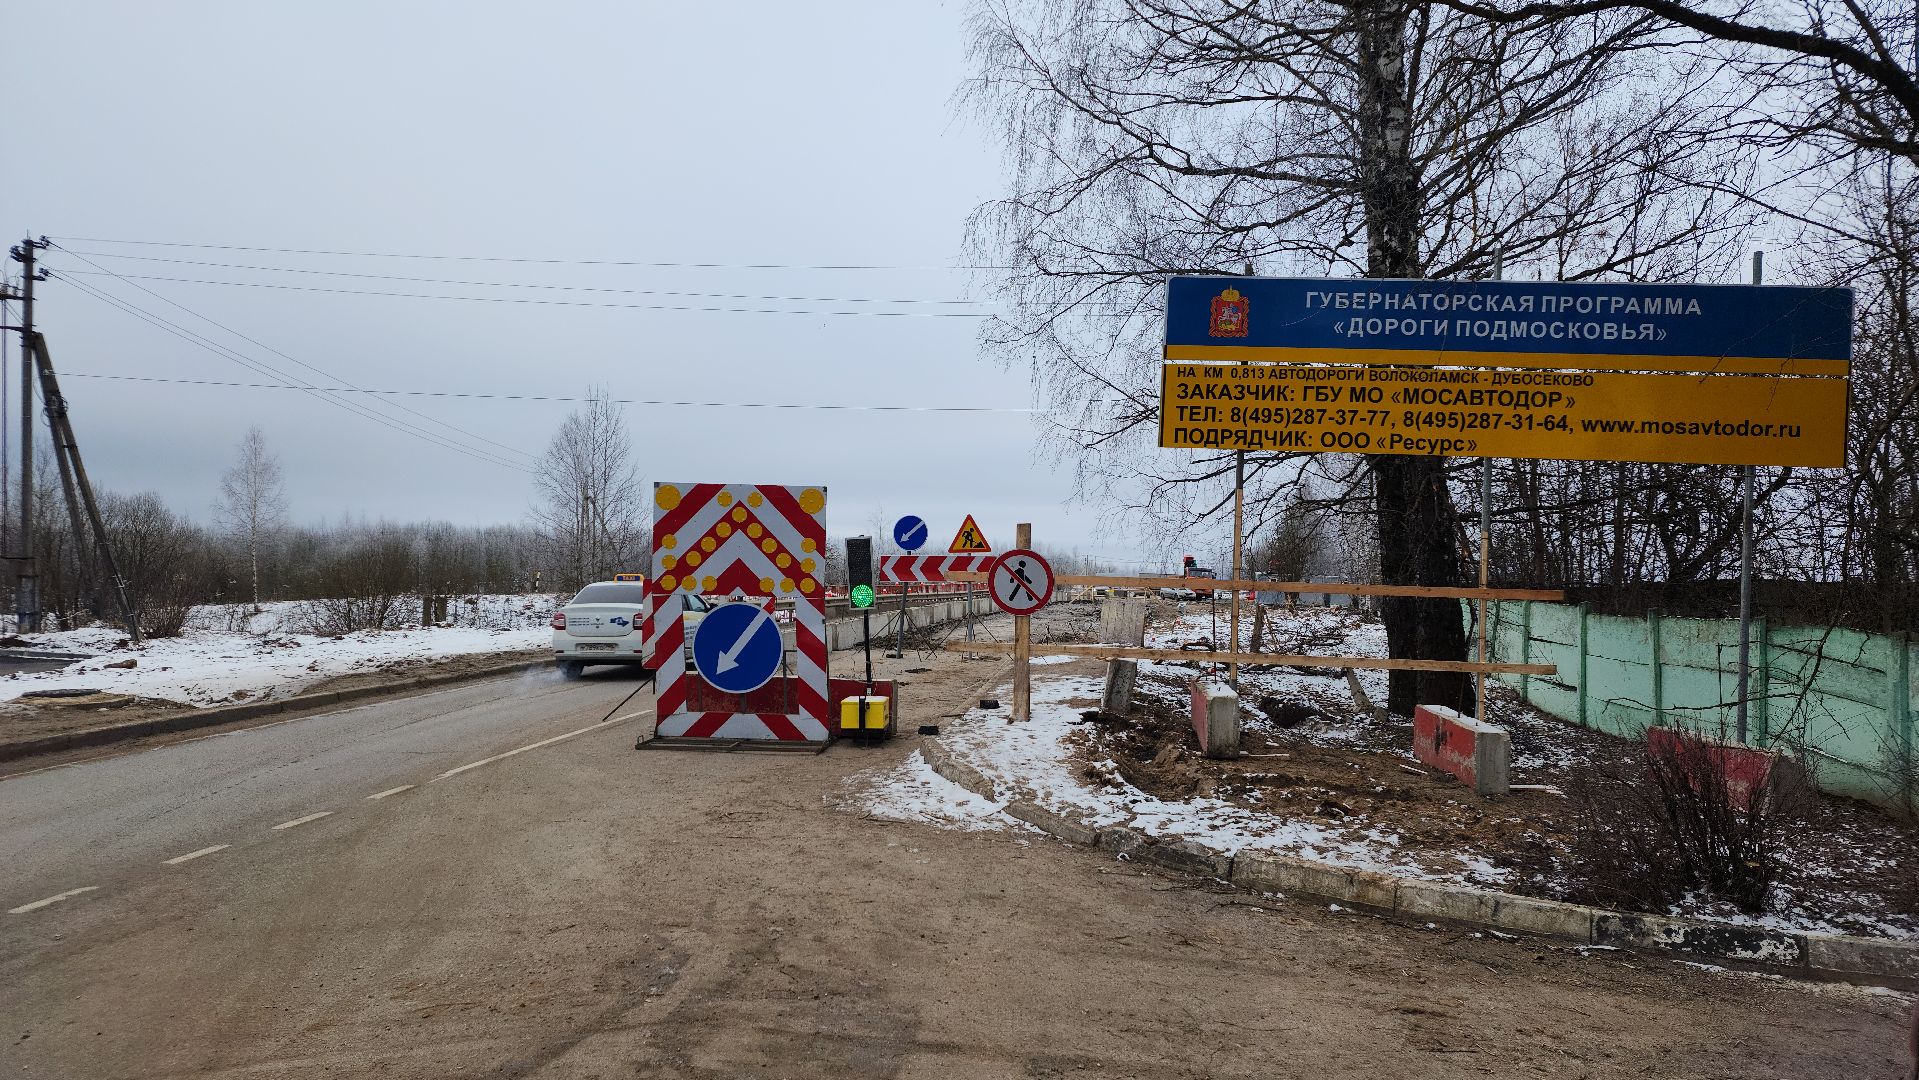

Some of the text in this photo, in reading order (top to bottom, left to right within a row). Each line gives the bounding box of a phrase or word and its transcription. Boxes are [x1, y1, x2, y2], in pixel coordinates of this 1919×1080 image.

[1306, 291, 1702, 316] ГУБЕРНАТОРСКАЯ ПРОГРАММА
[1333, 317, 1667, 341] «ДОРОГИ ПОДМОСКОВЬЯ»
[1177, 366, 1197, 378] НА
[1204, 367, 1223, 379] КМ
[1230, 367, 1265, 380] 0,813
[1268, 368, 1365, 382] АВТОДОРОГИ
[1369, 370, 1480, 384] ВОЛОКОЛАМСК
[1491, 373, 1594, 387] ДУБОСЕКОВО
[1176, 382, 1576, 410] ЗАКАЗЧИК: ГБУ МО «МОСАВТОДОР»
[1175, 405, 1801, 439] ТЕЛ: 8(495)287-37-77, 8(495)287-31-64, www.mosavtodor.ru
[1174, 427, 1478, 455] ПОДРЯДЧИК: ООО «Ресурс»
